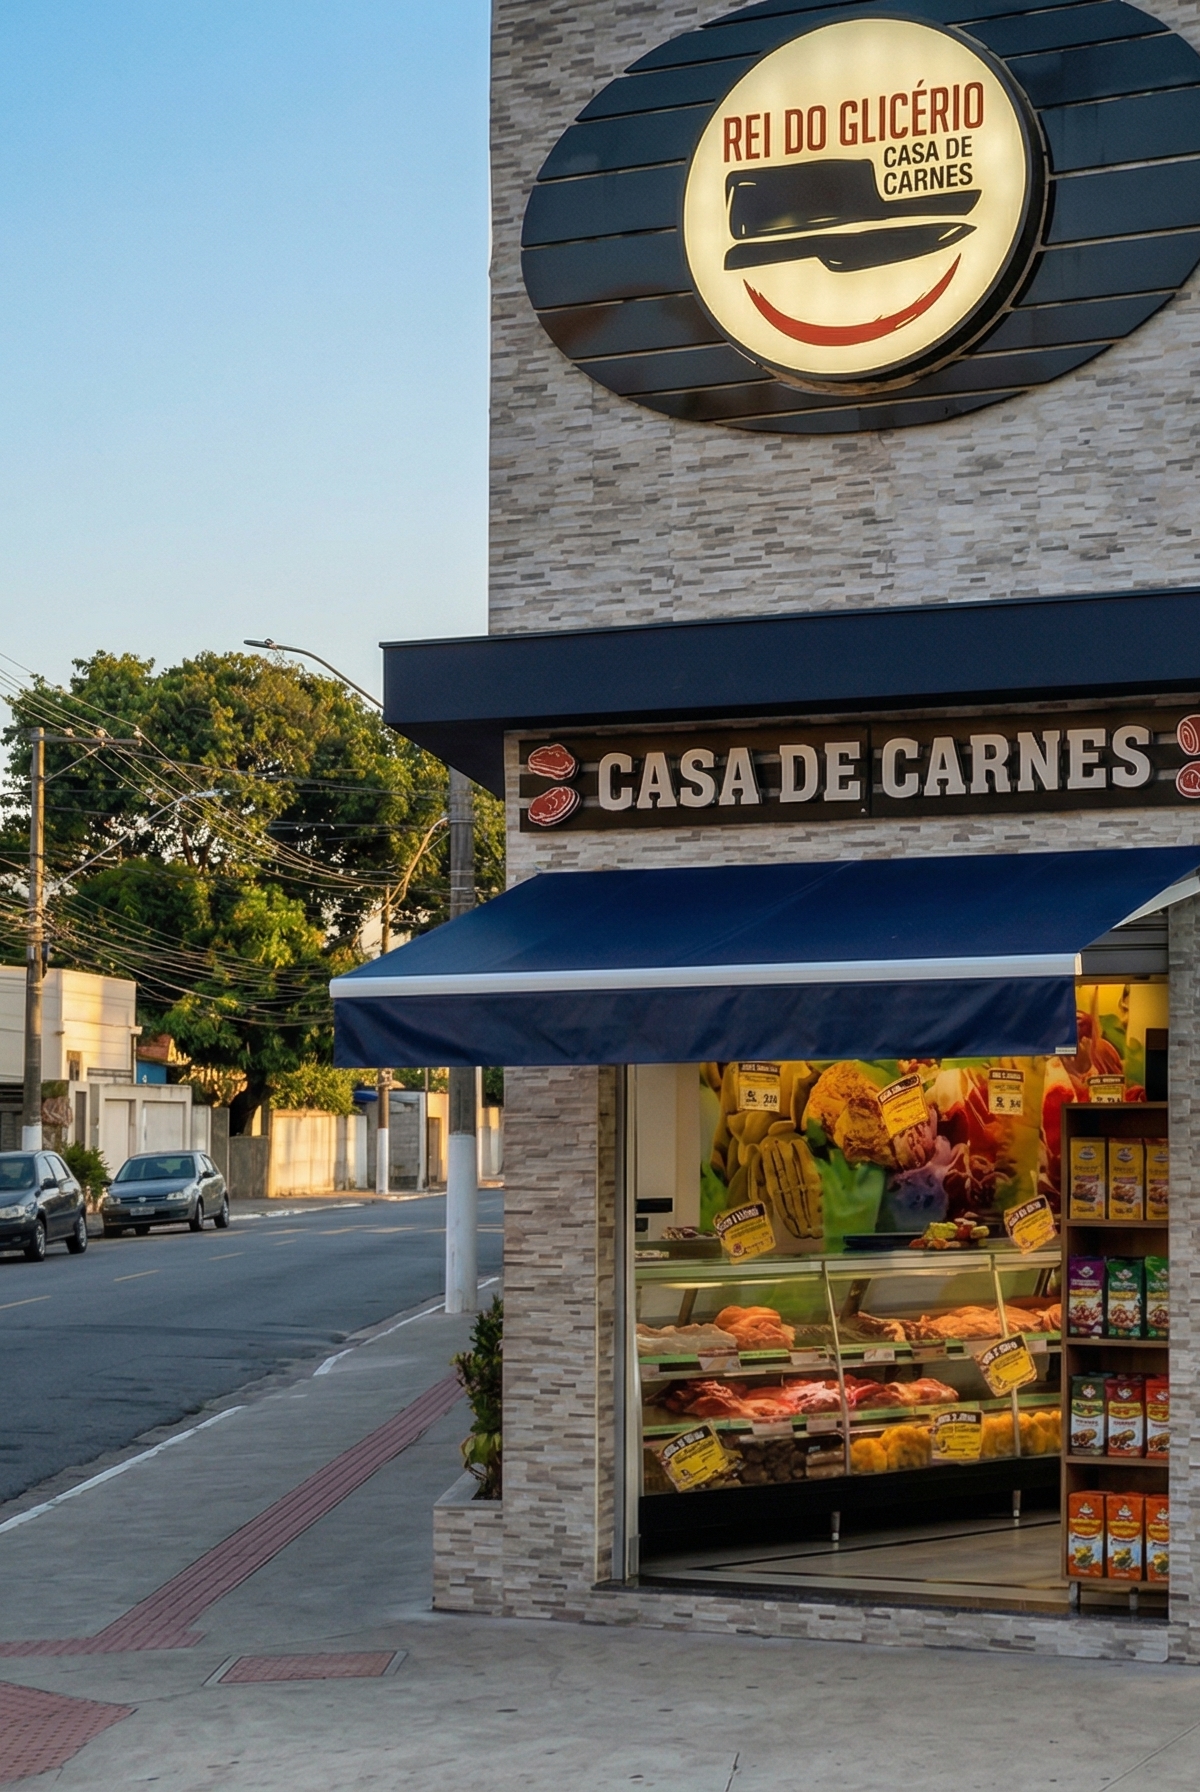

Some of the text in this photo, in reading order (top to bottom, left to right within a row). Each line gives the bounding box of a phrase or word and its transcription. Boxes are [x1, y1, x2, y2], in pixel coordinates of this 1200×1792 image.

[723, 79, 984, 163] REI DO GLICÉRIO
[883, 136, 973, 168] CASA DE
[883, 162, 974, 195] CARNES
[598, 725, 1151, 811] CASA DE CARNES
